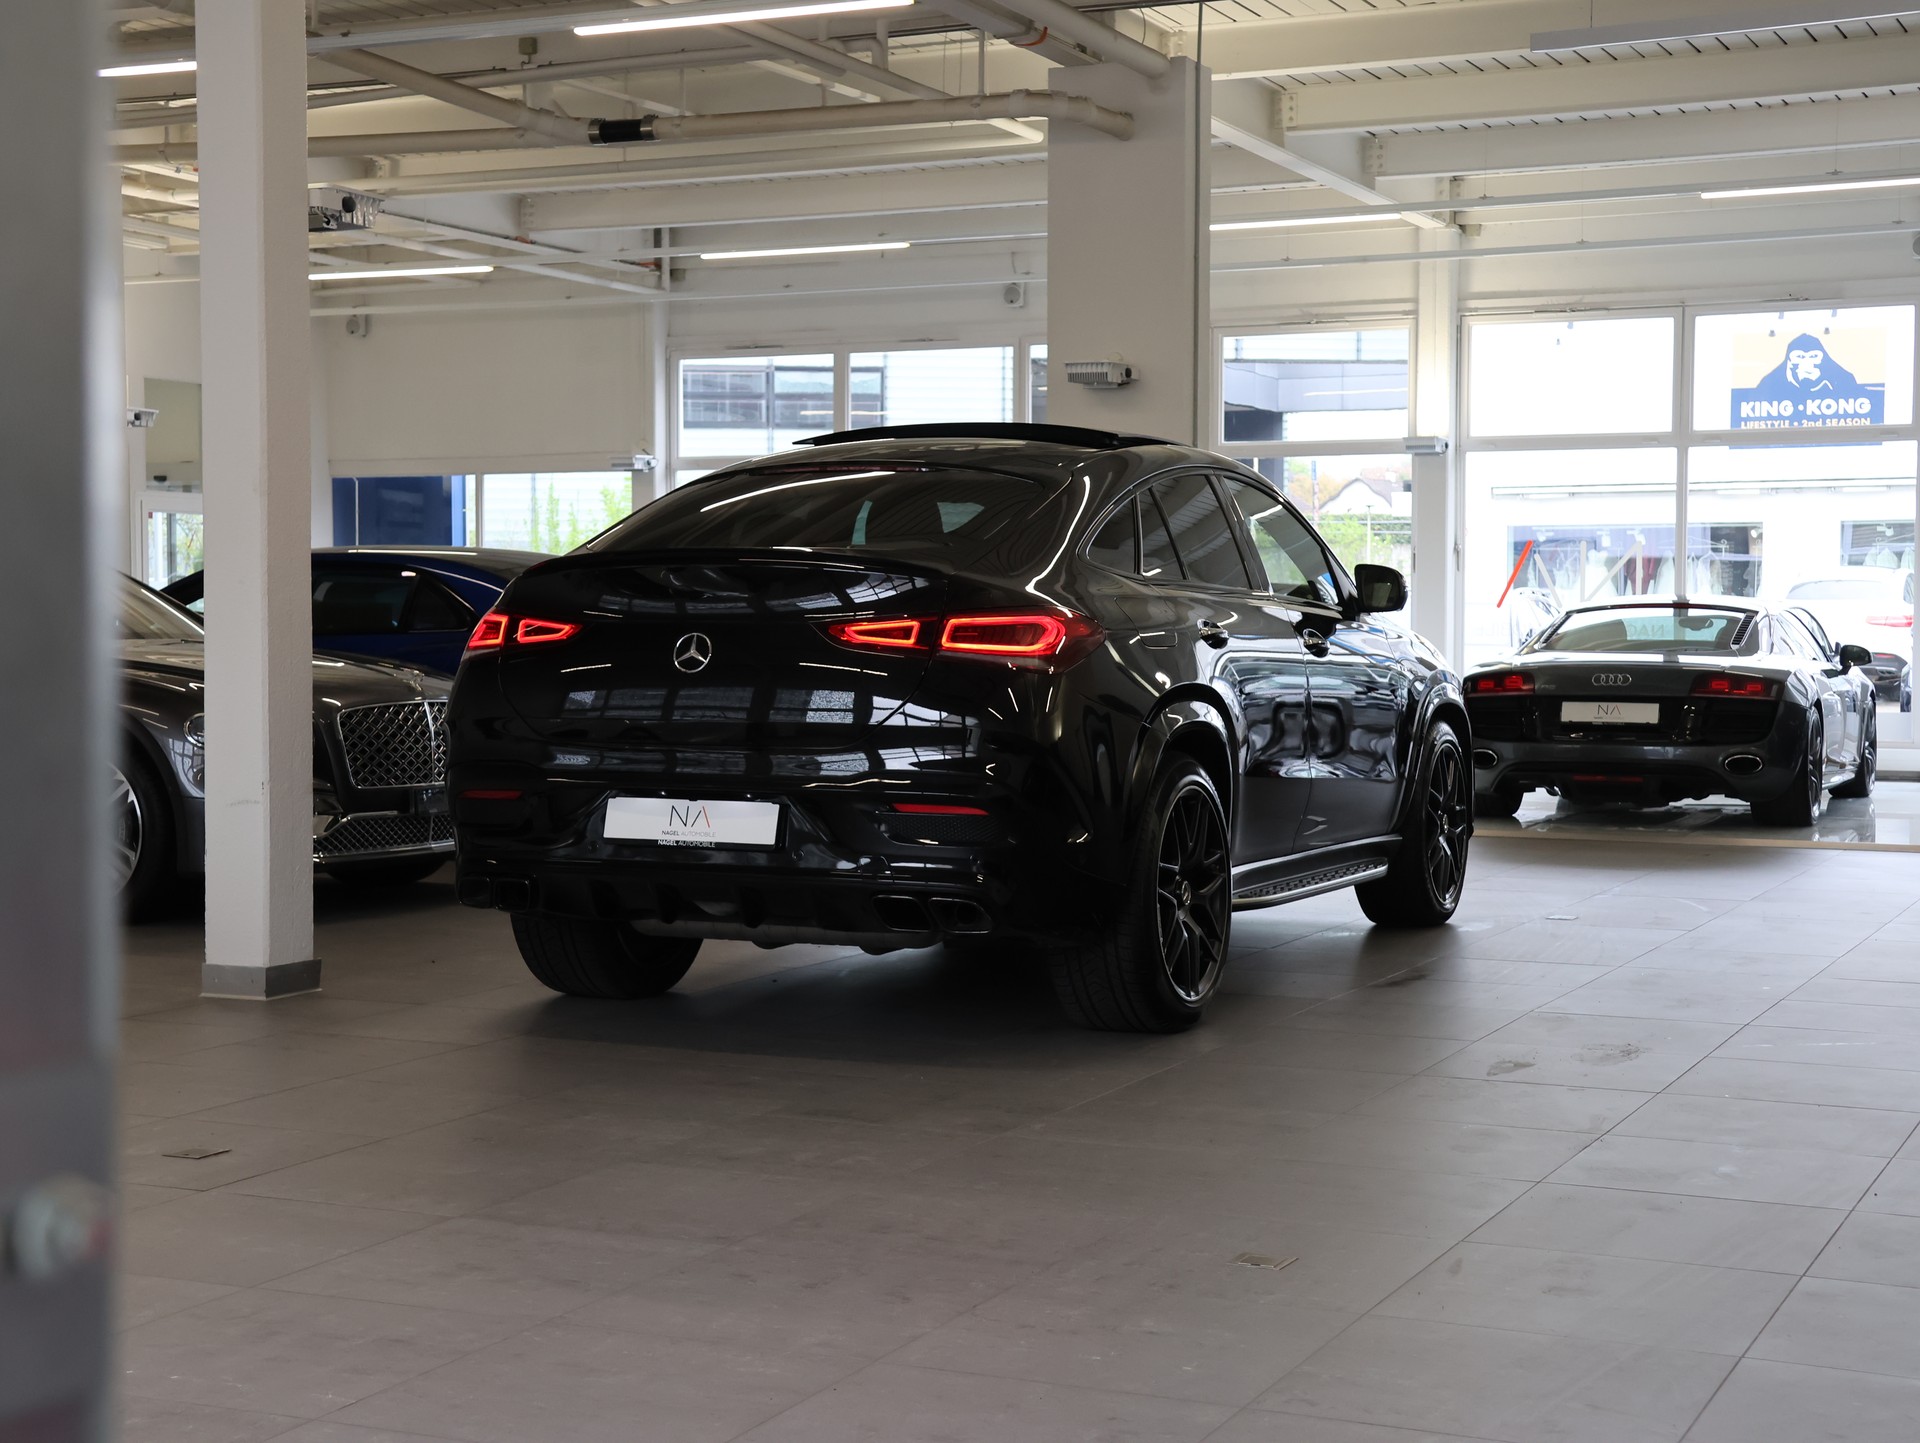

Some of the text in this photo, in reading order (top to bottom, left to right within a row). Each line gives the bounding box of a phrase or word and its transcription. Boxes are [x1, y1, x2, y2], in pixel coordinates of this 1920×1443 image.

[1740, 397, 1872, 417] KING KONG
[1741, 417, 1871, 429] LIFESTYLE 2nd SEASON
